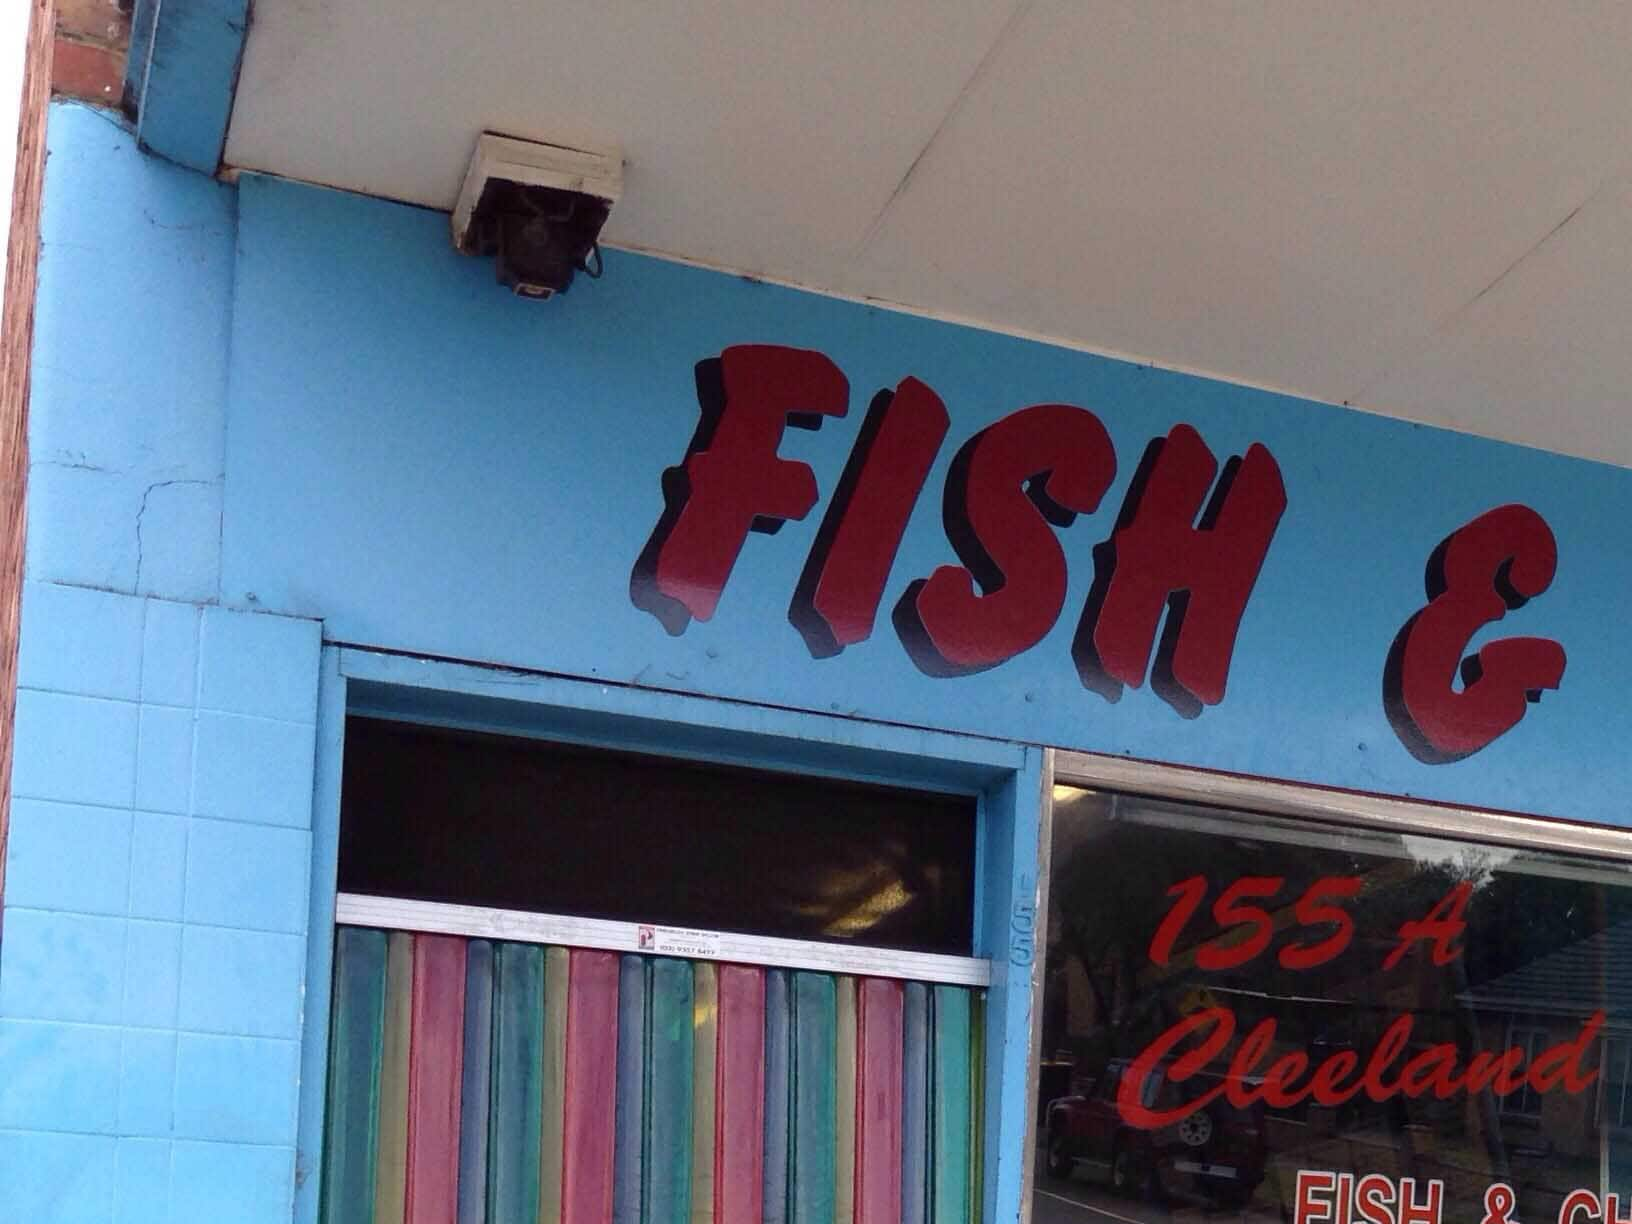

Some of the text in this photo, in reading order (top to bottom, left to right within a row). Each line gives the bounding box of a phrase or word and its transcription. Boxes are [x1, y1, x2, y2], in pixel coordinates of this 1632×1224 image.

[630, 344, 1288, 719] FISH
[1383, 504, 1566, 766] &
[1147, 875, 1474, 972] 155 A
[1116, 1006, 1608, 1131] Cleeland
